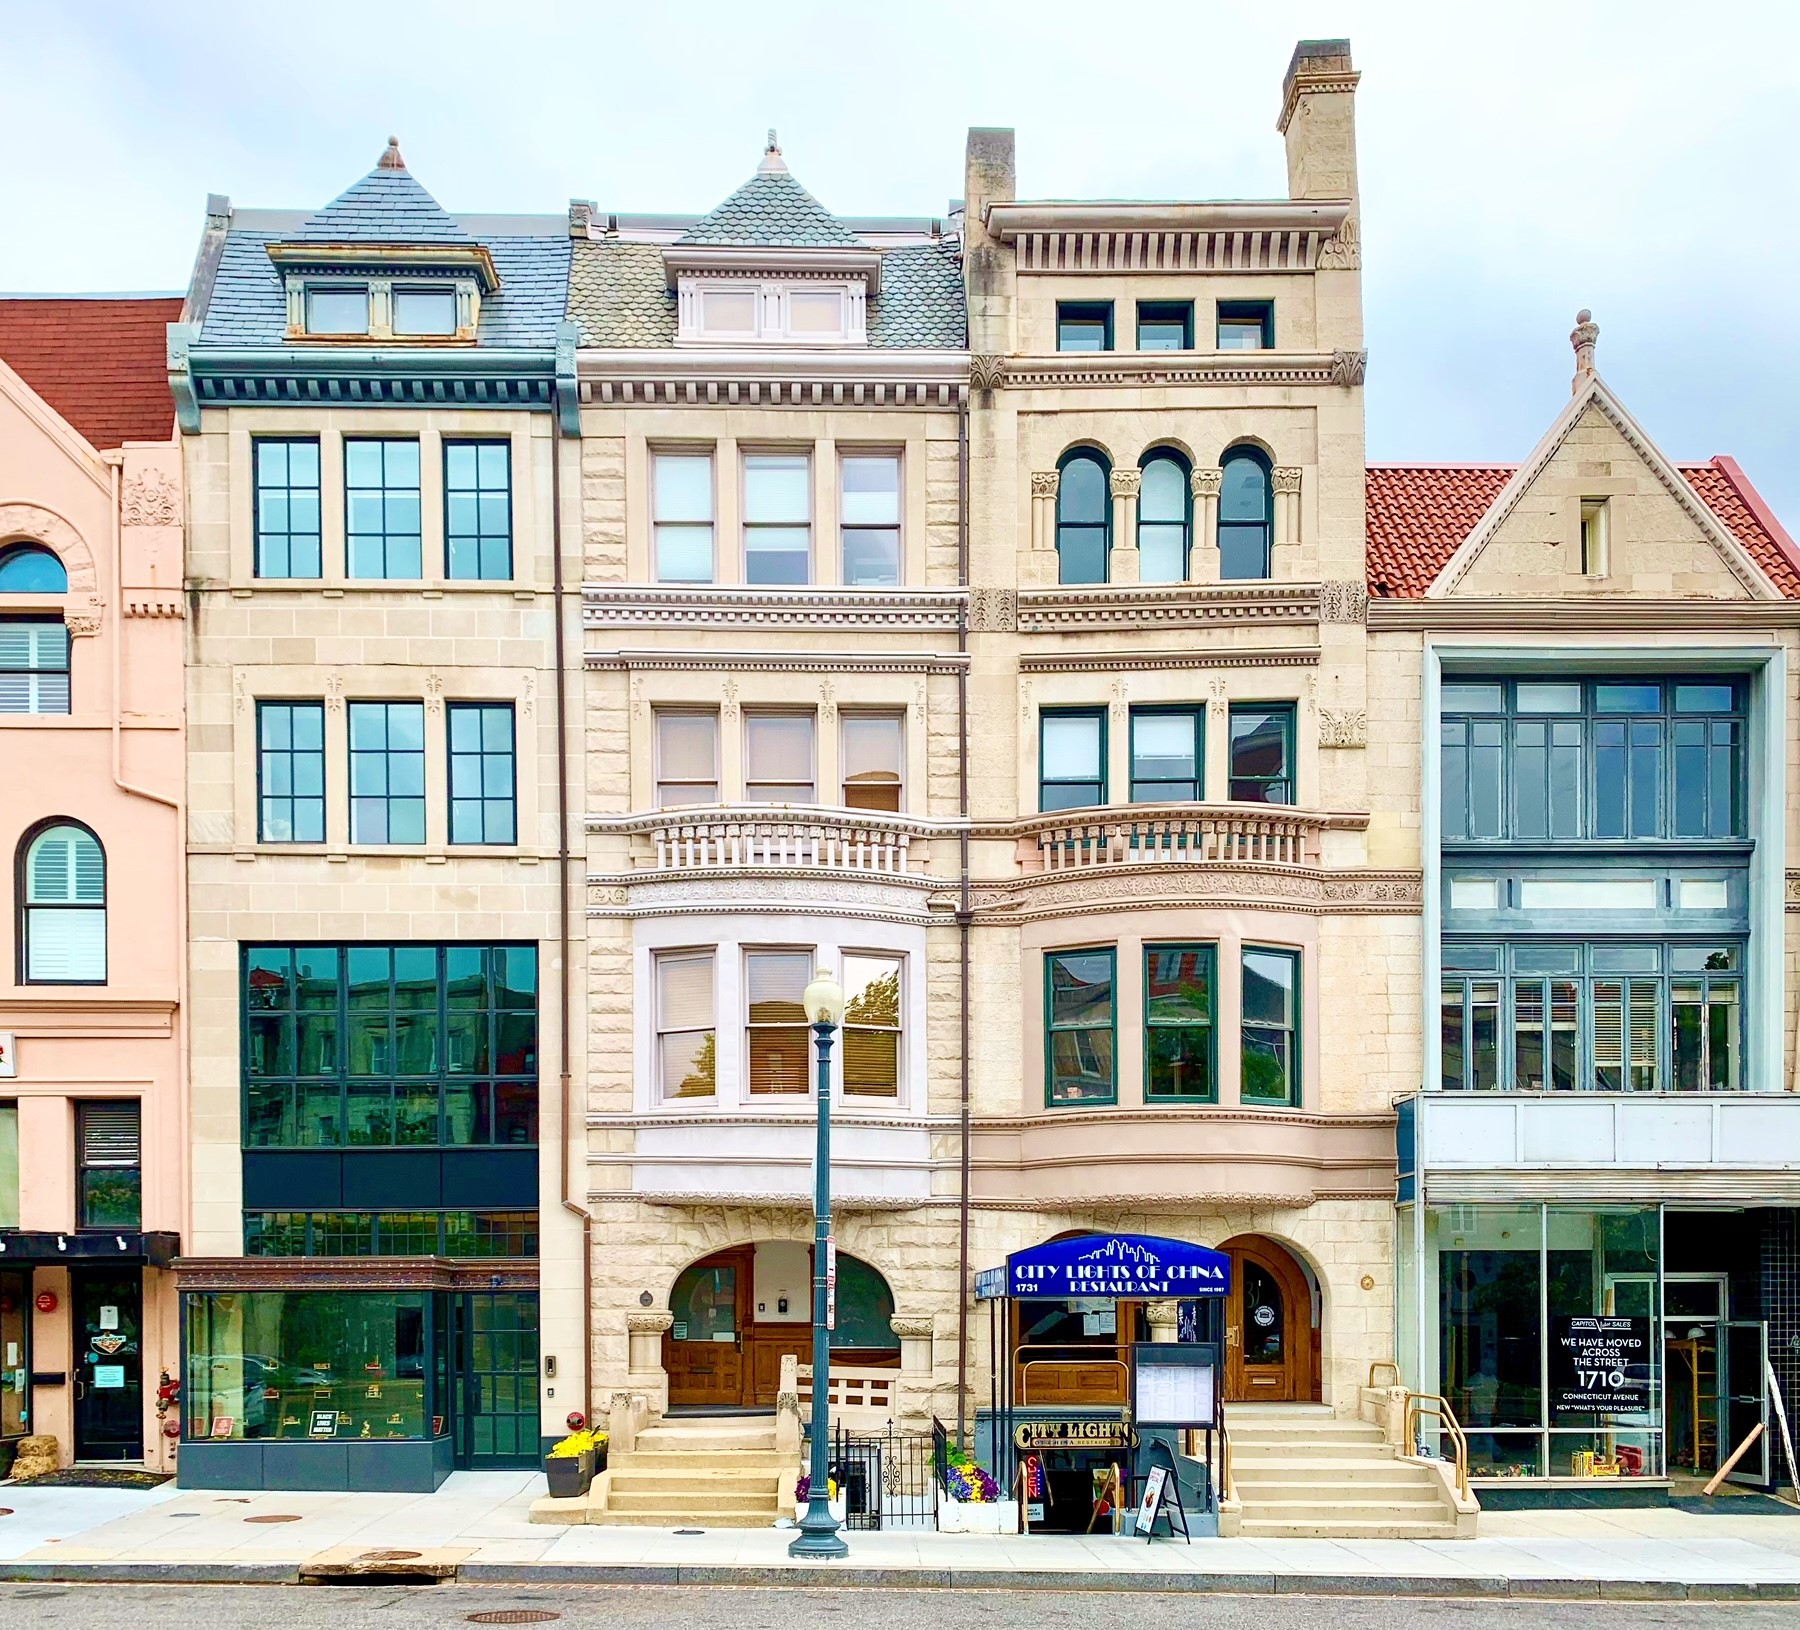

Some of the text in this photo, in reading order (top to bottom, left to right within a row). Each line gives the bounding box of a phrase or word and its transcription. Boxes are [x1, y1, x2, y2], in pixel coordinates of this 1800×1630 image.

[1016, 1265, 1224, 1279] CITY LIGHTS OF CHINA
[1015, 1283, 1038, 1292] 1731
[1070, 1281, 1170, 1292] RESTAURANT
[1561, 1338, 1641, 1347] WE HAVE MOVED
[1582, 1348, 1620, 1357] ACROSS
[1573, 1357, 1629, 1367] THE STREET
[1578, 1371, 1624, 1389] 1710
[1014, 1423, 1140, 1448] CITY LIGHTS
